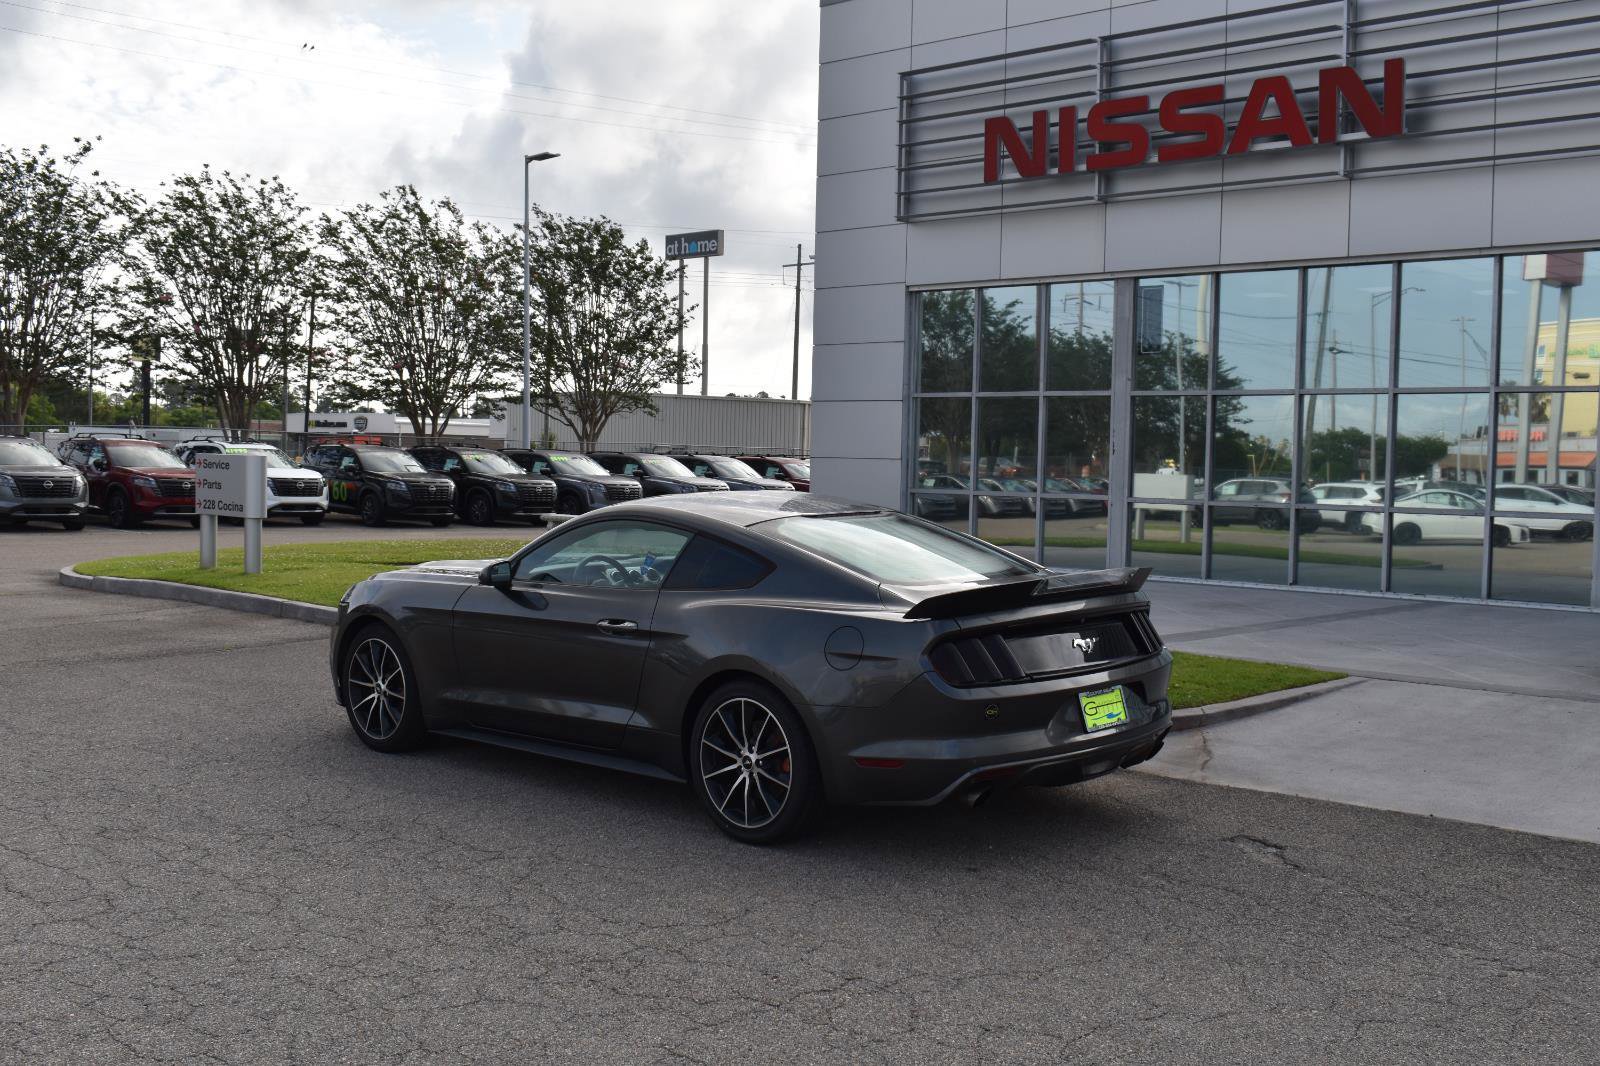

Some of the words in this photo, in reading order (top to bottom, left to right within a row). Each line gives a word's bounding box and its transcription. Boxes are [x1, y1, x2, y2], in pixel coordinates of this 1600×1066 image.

[984, 57, 1405, 184] NISSAN
[666, 241, 679, 256] at
[202, 458, 230, 470] Service
[202, 478, 222, 490] Parts
[203, 499, 216, 510] 228
[217, 500, 244, 512] Cocina
